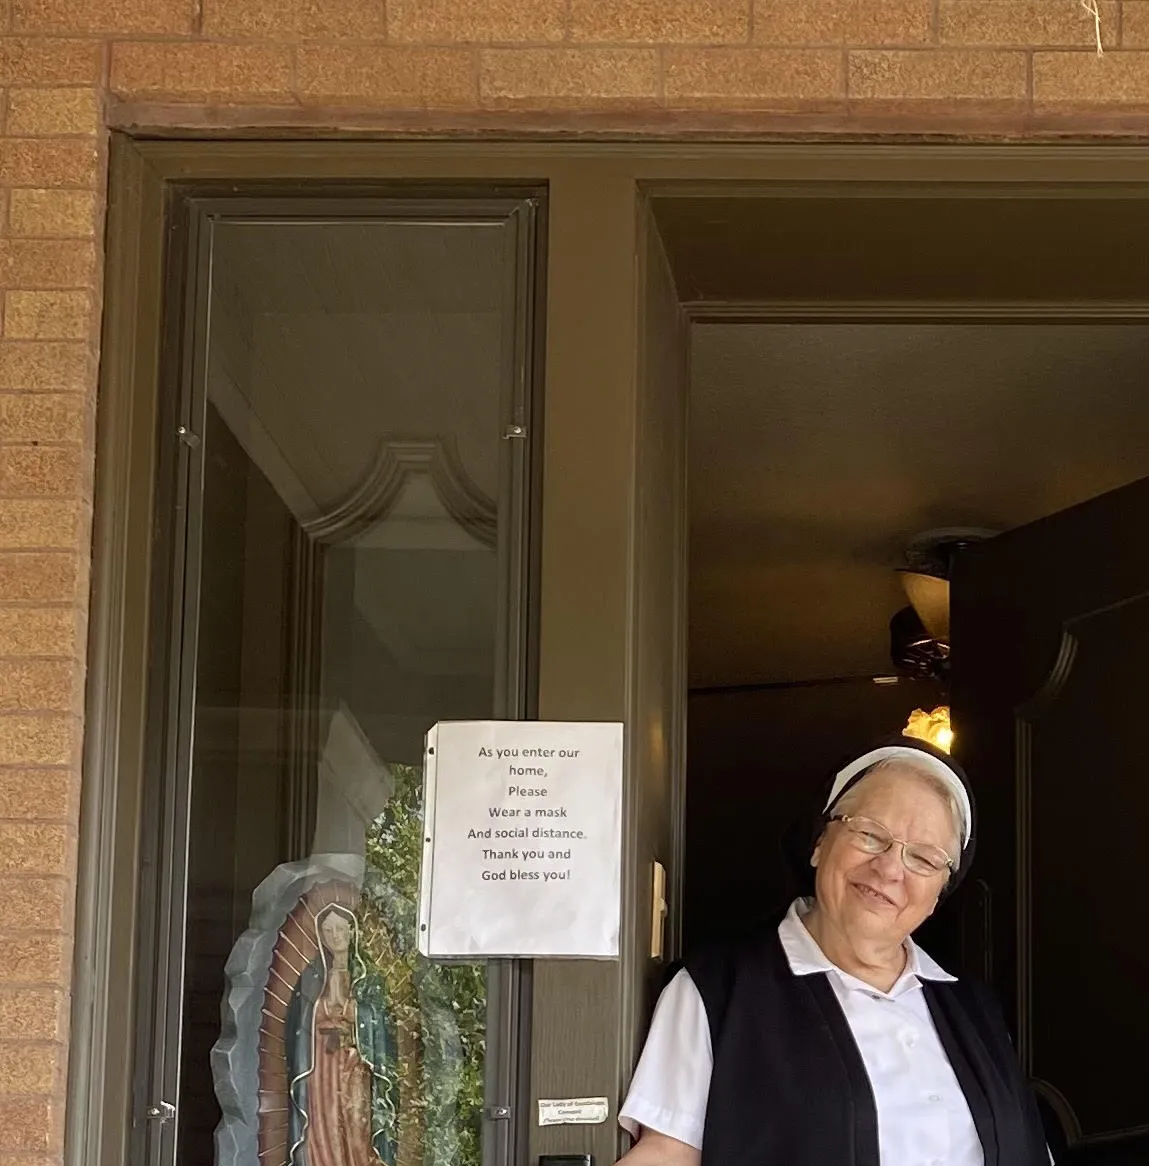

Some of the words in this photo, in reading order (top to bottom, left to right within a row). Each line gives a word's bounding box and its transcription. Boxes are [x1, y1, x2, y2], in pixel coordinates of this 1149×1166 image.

[478, 746, 493, 758] As
[496, 748, 519, 760] you
[522, 747, 555, 758] enter
[558, 748, 580, 758] our
[509, 764, 548, 777] home,
[508, 786, 548, 797] Please
[488, 807, 522, 818] Wear
[524, 809, 532, 818] a
[535, 806, 568, 818] mask
[467, 827, 492, 839] And
[495, 827, 529, 839] social
[532, 827, 588, 840] distance.
[482, 848, 519, 860] Thank
[522, 850, 545, 862] you
[547, 848, 571, 860] and
[481, 869, 506, 881] God
[509, 868, 540, 881] bless
[543, 869, 571, 882] you!
